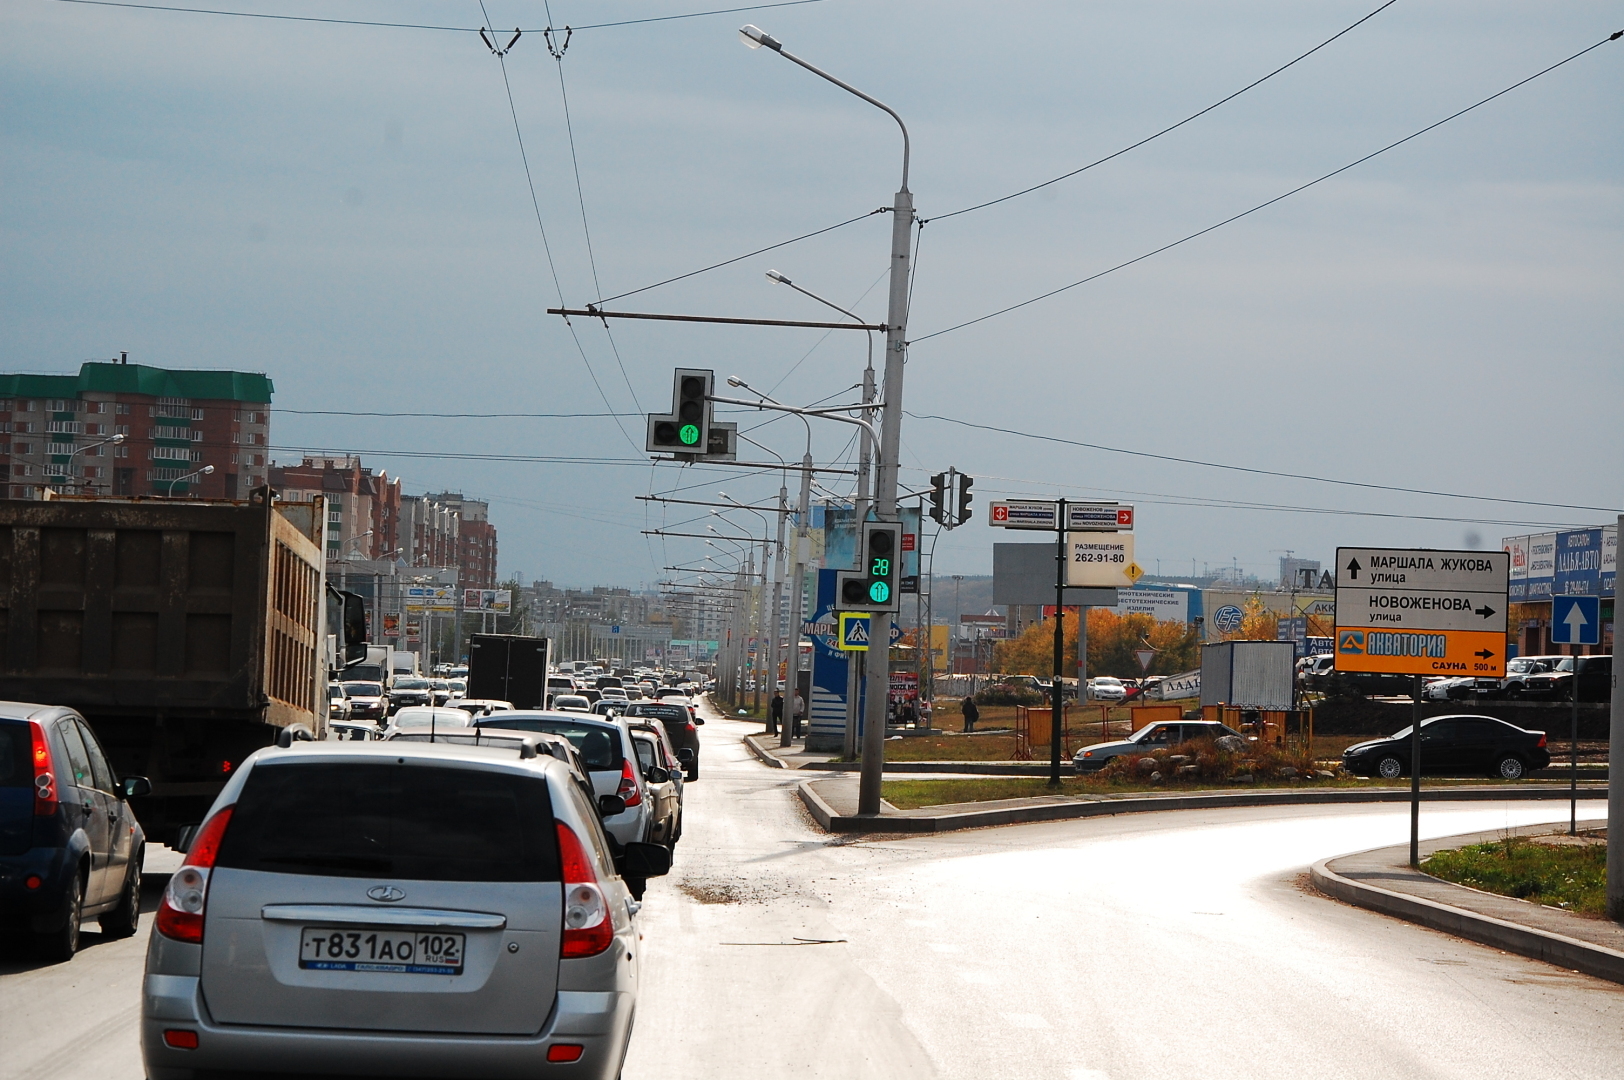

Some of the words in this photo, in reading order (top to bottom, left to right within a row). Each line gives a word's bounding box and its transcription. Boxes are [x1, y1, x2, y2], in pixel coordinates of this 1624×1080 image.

[1075, 553, 1125, 563] 262-91-80
[1370, 556, 1434, 569] МАРШАЛА
[1441, 558, 1493, 572] ЖУКОВА
[1557, 550, 1599, 575] ЛАДЬЯ-АВТО
[872, 558, 889, 576] 28
[1370, 572, 1406, 585] улица
[1369, 596, 1472, 611] НОВОЖЕНОВА
[1369, 613, 1402, 623] улица
[1367, 632, 1446, 658] АКВАТОРИЯ
[1432, 662, 1467, 671] САУНА
[1474, 663, 1488, 671] 500
[311, 933, 413, 960] Т831АО
[418, 935, 456, 957] 102
[425, 955, 444, 963] RUS
